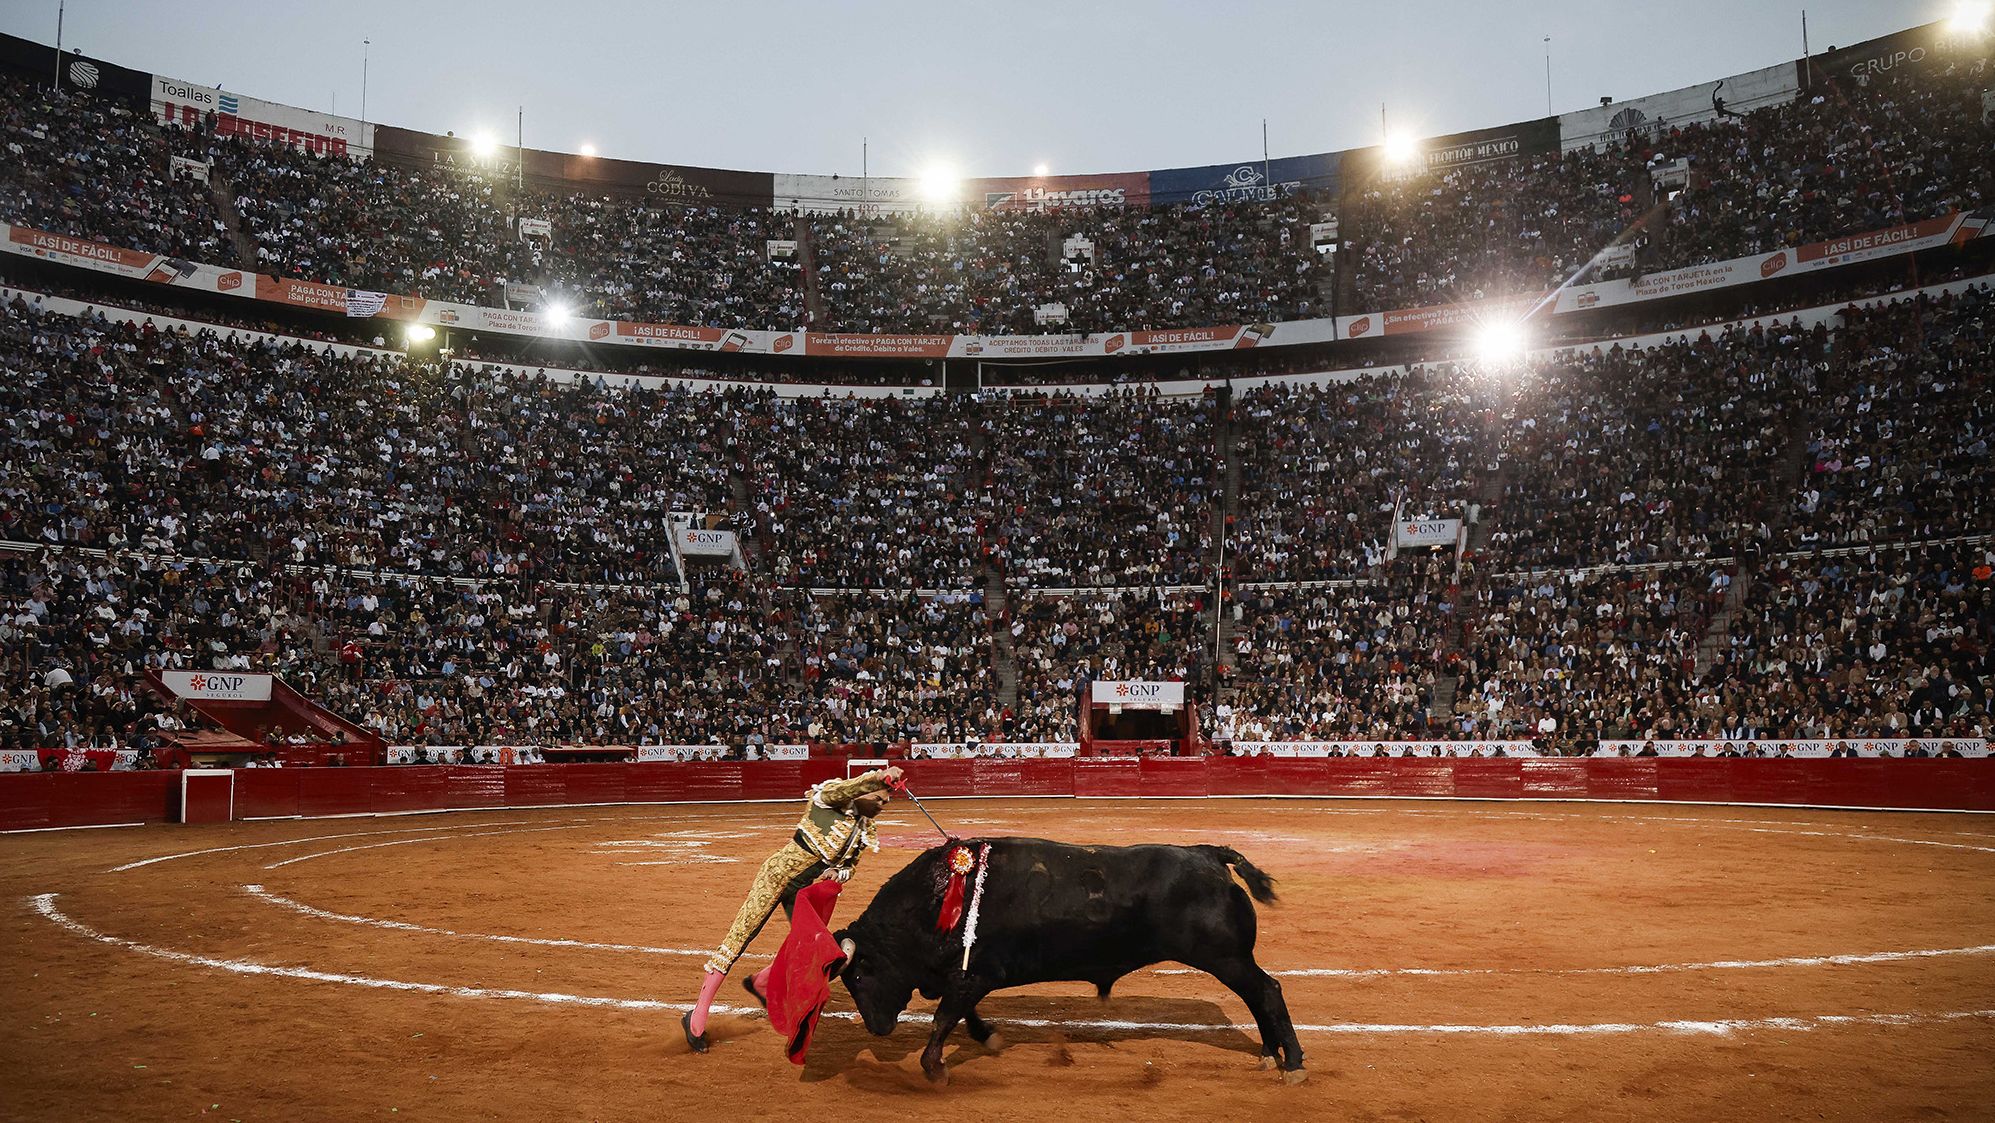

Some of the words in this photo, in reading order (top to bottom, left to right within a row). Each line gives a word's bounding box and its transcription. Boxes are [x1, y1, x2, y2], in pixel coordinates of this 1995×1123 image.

[1850, 47, 1926, 75] GRUPO
[159, 80, 212, 104] Toallas
[325, 123, 347, 136] M.R.
[433, 151, 456, 166] LA
[659, 169, 684, 186] Lady
[647, 181, 710, 198] GODIVA
[834, 188, 863, 197] SANTO
[1824, 238, 1851, 256] ¡ASÍ
[1854, 237, 1872, 250] DE
[1874, 226, 1918, 246] FÁCIL!
[33, 234, 60, 250] ¡ASÍ
[62, 240, 80, 254] DE
[81, 244, 122, 262] FÁCIL!
[1652, 276, 1670, 286] CON
[1672, 269, 1711, 283] TARJETA
[1724, 265, 1733, 273] la
[291, 285, 315, 296] PAGA
[316, 289, 334, 298] CON
[1635, 287, 1658, 297] Plaza
[1659, 285, 1669, 294] de
[1672, 281, 1695, 291] Toros
[1696, 276, 1726, 287] México
[288, 292, 304, 301] ¡Sal
[305, 296, 320, 304] por
[321, 297, 329, 305] la
[483, 312, 502, 321] PAGA
[503, 314, 518, 322] CON
[488, 321, 507, 330] Plaza
[634, 326, 654, 336] ¡ASÍ
[655, 328, 669, 338] DE
[669, 328, 701, 340] FÁCIL!
[1148, 333, 1168, 343] ¡ASÍ
[1169, 333, 1182, 342] DE
[1183, 331, 1214, 342] FÁCIL!
[913, 338, 946, 346] TARJETA
[1419, 523, 1446, 533] GNP
[697, 533, 723, 543] GNP
[207, 676, 244, 691] GNP
[1130, 685, 1160, 696] GNP
[1797, 743, 1820, 751] GNP
[1875, 743, 1898, 751] GNP
[1955, 743, 1980, 751] GNP
[12, 754, 35, 764] GNP
